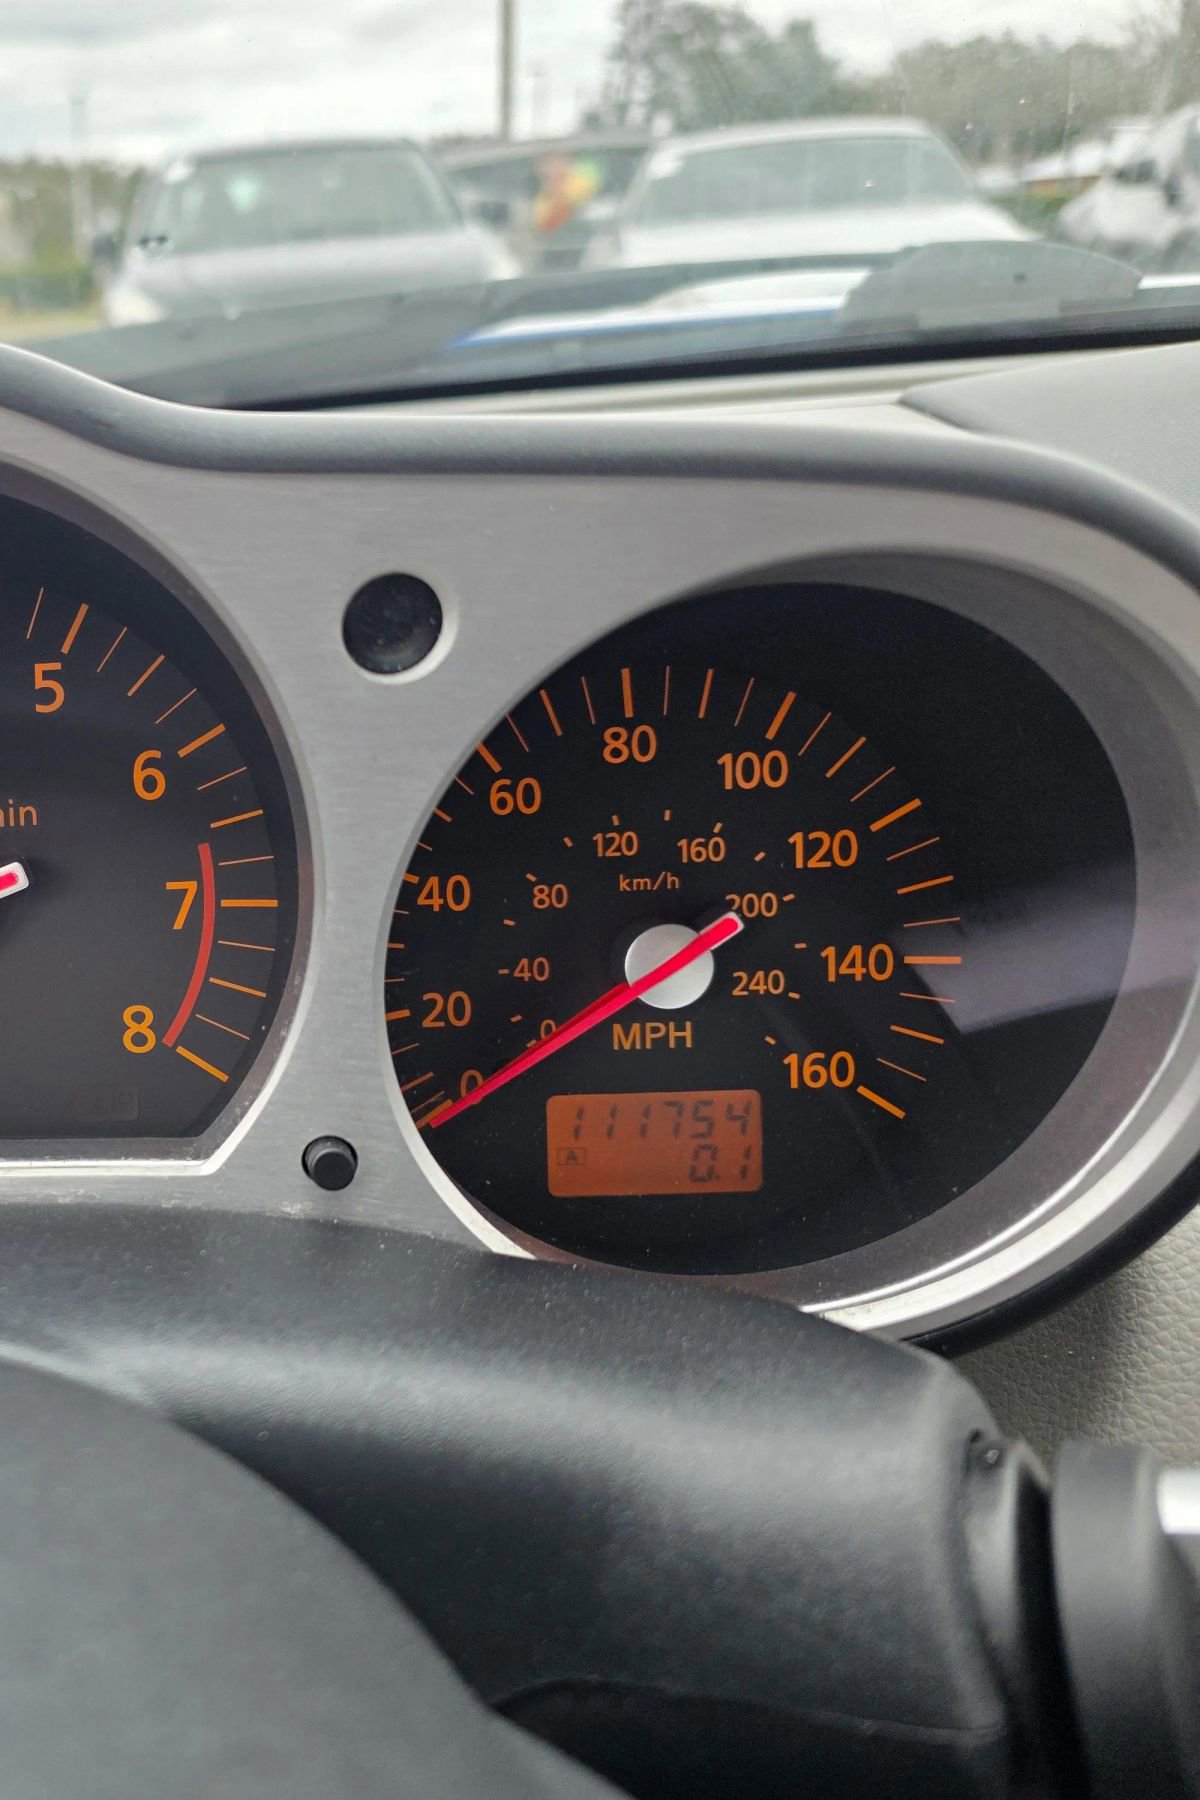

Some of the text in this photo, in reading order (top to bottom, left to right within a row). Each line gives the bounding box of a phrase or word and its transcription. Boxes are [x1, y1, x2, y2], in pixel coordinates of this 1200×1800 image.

[33, 661, 65, 713] 5
[602, 724, 657, 765] 80
[132, 749, 167, 801] 6
[717, 749, 789, 791] 100
[489, 776, 542, 816] 60
[593, 832, 640, 858] 120
[678, 835, 726, 864] 160
[787, 828, 860, 869] 120
[416, 874, 472, 913] 40
[532, 884, 570, 909] 80
[618, 871, 681, 892] km/h
[164, 879, 196, 930] 7
[513, 956, 551, 982] 40
[731, 969, 785, 996] 240
[820, 944, 895, 983] 140
[121, 1004, 158, 1054] 8
[421, 991, 473, 1028] 20
[611, 1021, 693, 1050] MPH
[783, 1050, 856, 1089] 160
[573, 1099, 751, 1141] 111754
